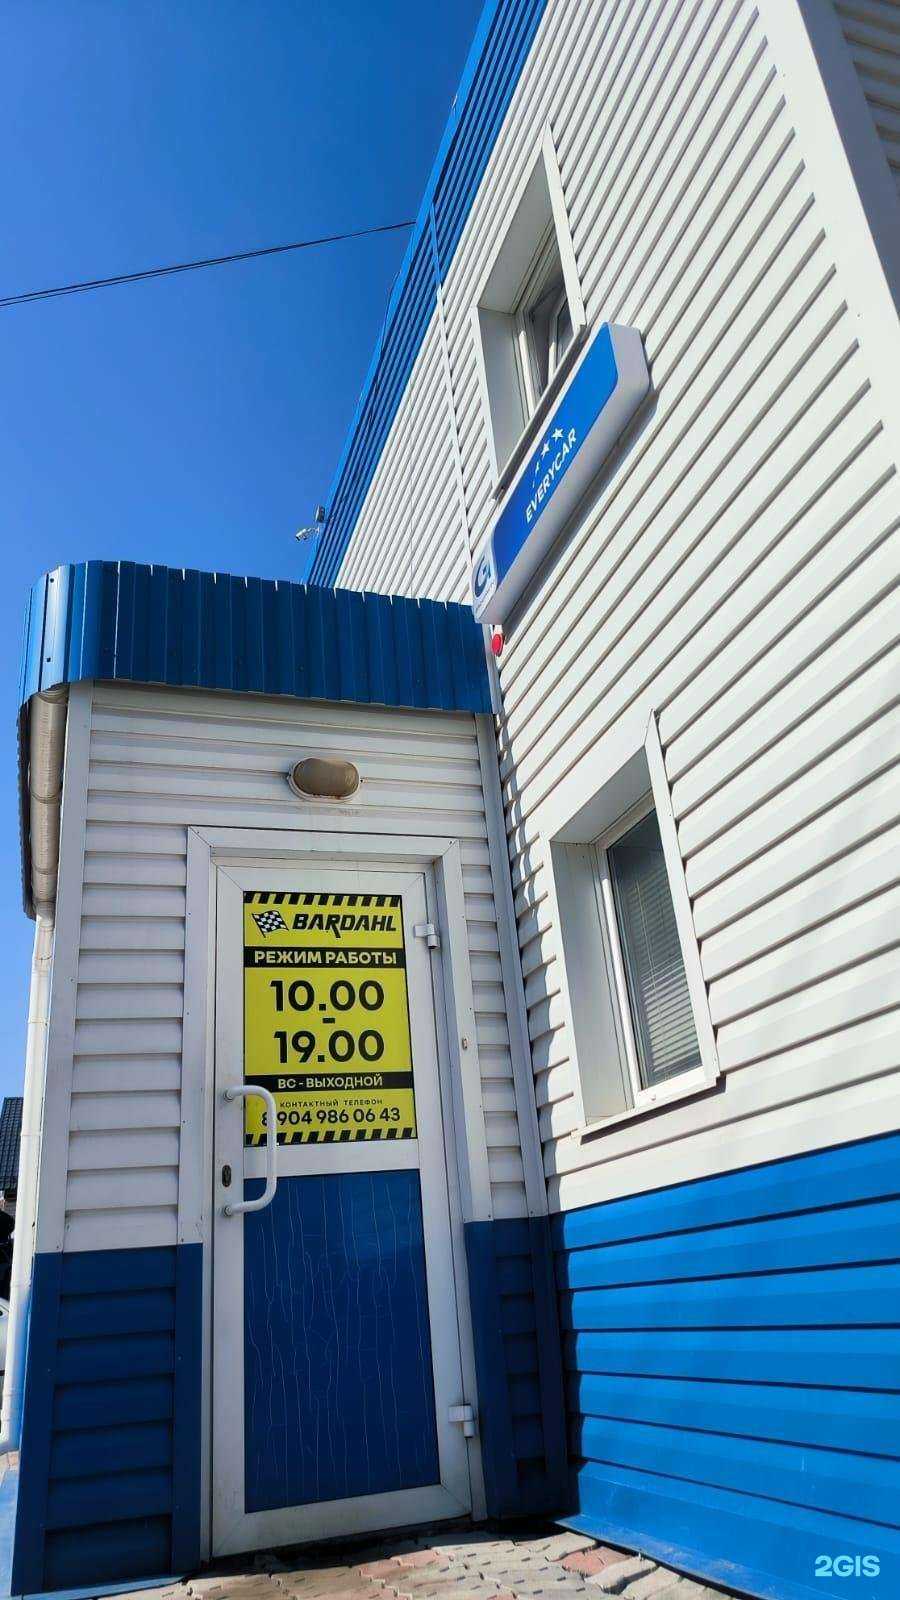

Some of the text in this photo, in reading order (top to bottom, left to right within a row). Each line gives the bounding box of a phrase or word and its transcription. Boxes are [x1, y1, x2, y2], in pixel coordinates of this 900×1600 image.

[525, 428, 577, 524] EVERYCAR
[292, 913, 396, 939] BARDAHL
[254, 951, 397, 965] РЕЖИМ РАБОТЫ
[270, 980, 384, 1012] 10.00
[274, 1029, 384, 1063] 19.00
[306, 1074, 383, 1089] ВЫХОДНОЙ
[280, 1099, 339, 1108] КОНТАКТНЫЙ
[277, 1110, 312, 1126] 904
[317, 1108, 349, 1124] 986
[353, 1108, 376, 1123] 06
[379, 1107, 400, 1122] 43
